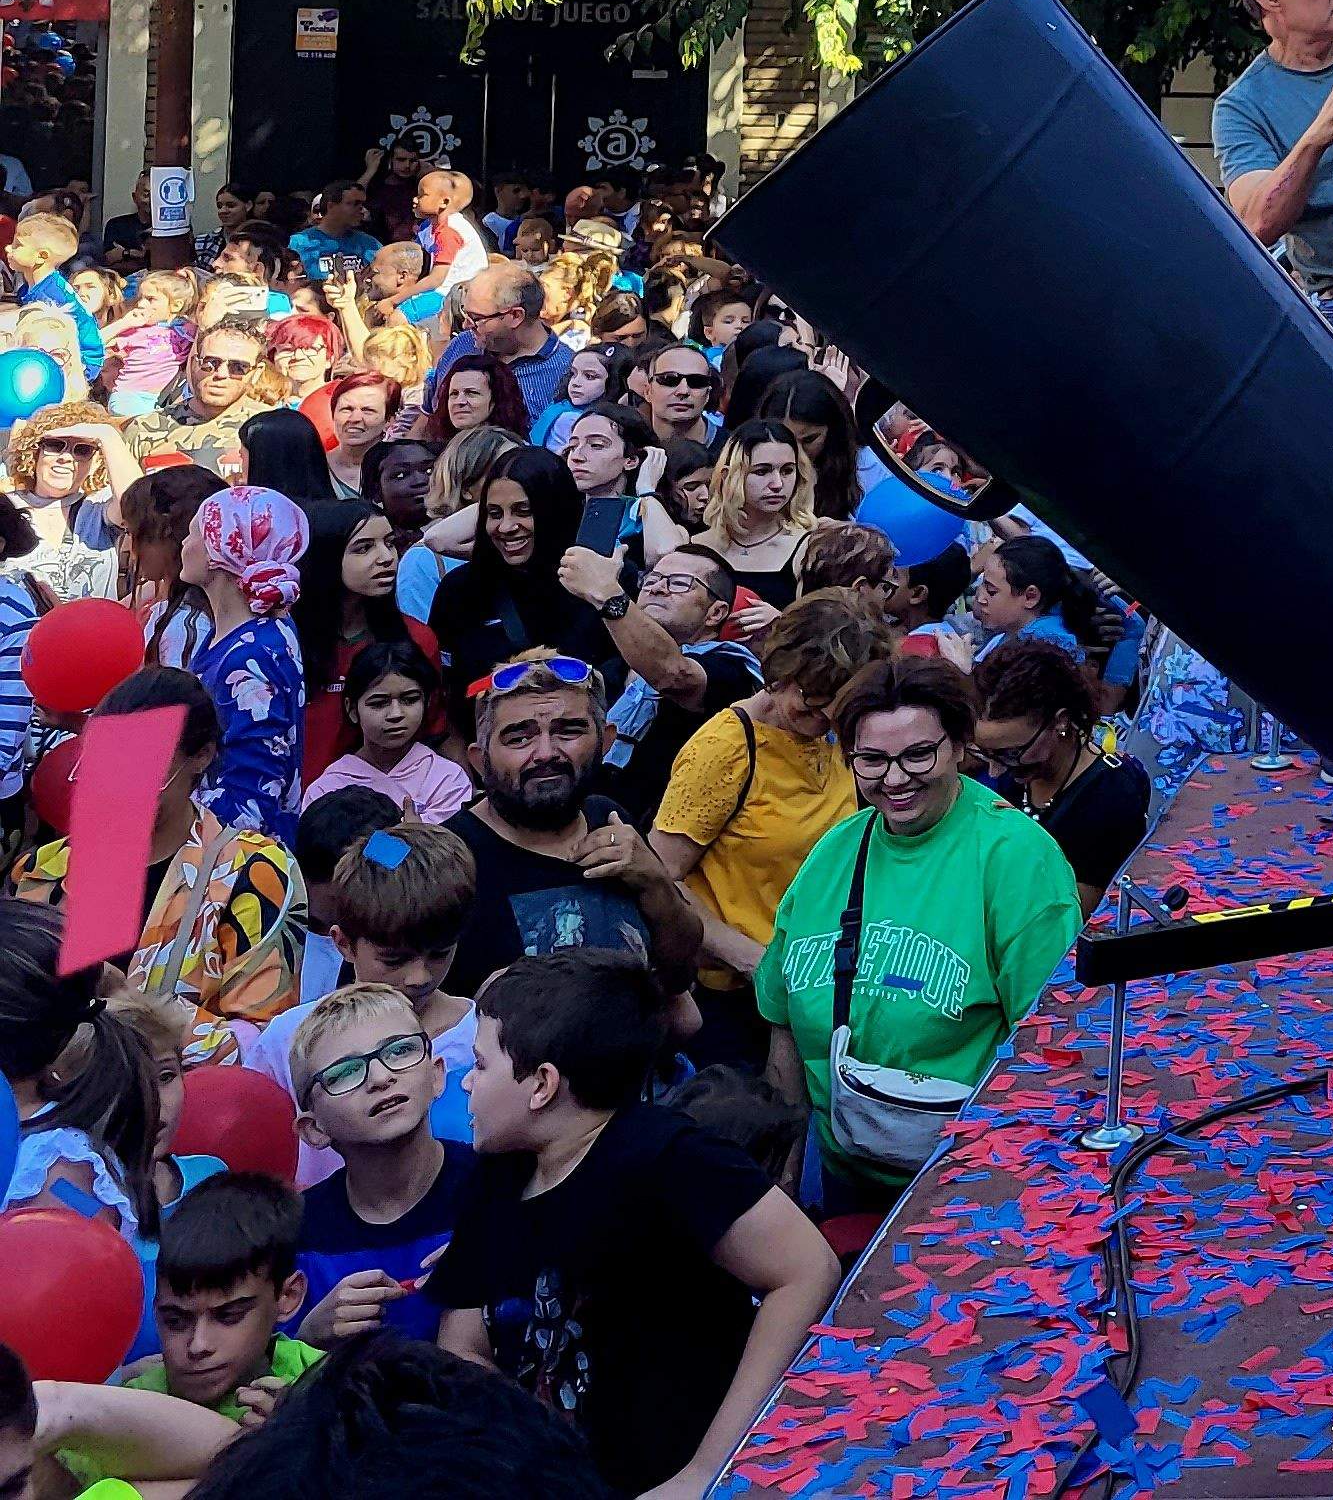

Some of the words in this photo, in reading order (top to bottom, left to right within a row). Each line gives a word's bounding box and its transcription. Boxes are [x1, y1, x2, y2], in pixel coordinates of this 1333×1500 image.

[415, 0, 501, 21] SAL
[550, 2, 631, 27] JUEGO
[781, 919, 971, 1022] ATÉTIQUE
